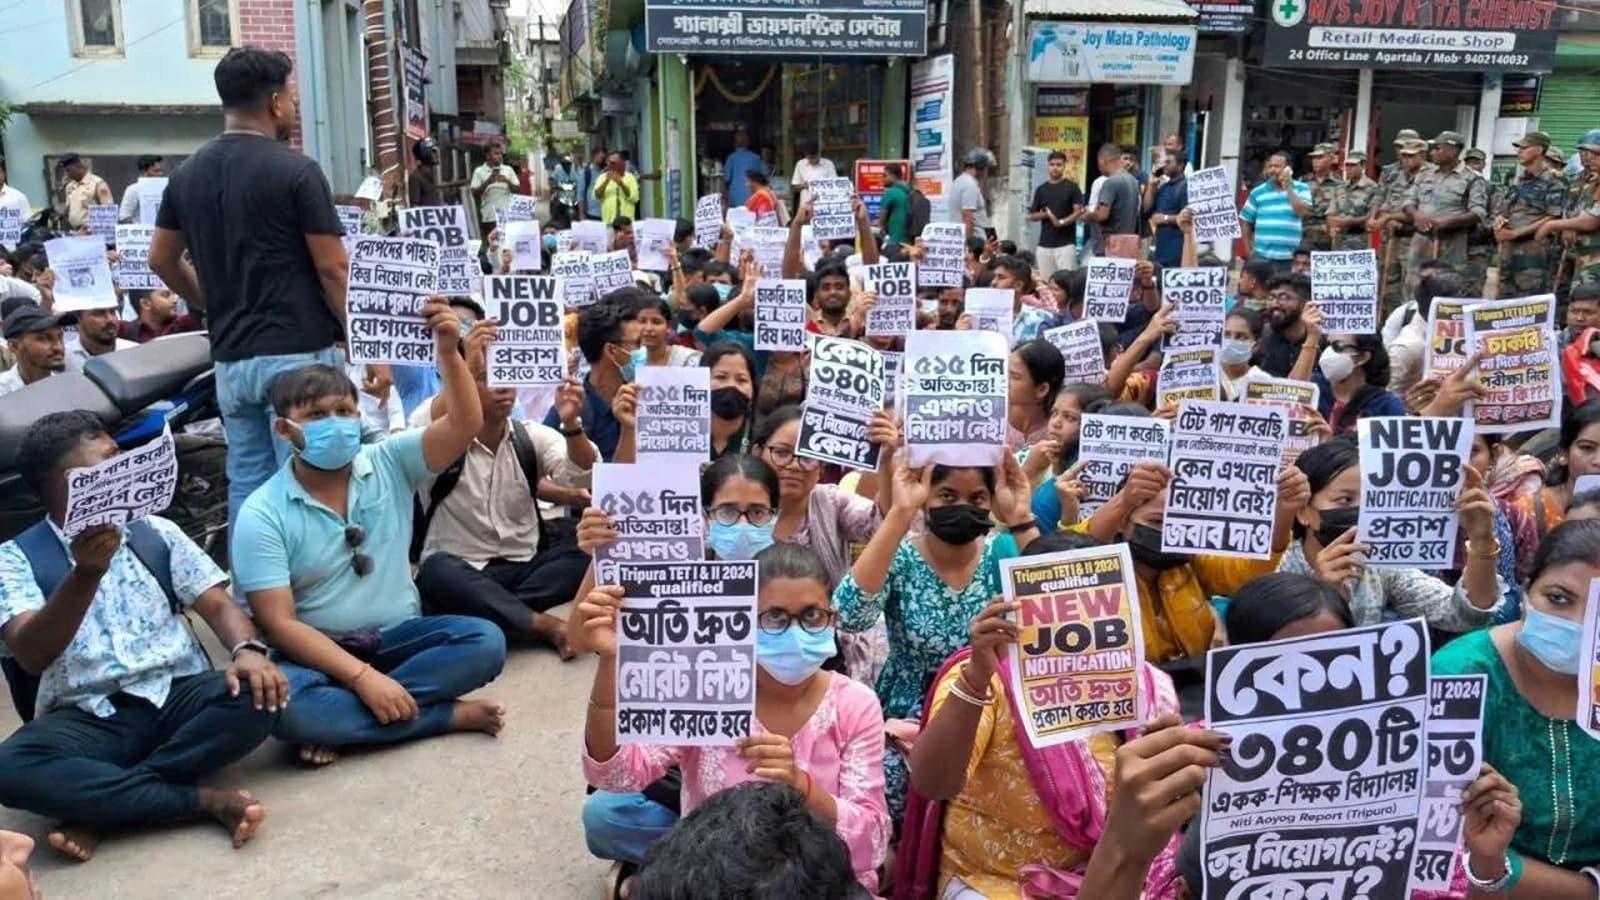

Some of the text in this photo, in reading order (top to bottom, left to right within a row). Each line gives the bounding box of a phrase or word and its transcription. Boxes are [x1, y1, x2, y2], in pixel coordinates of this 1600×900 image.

[849, 15, 901, 37] সেন্টার
[1354, 0, 1396, 25] JOY
[1465, 0, 1554, 30] CHEMIST
[1082, 30, 1190, 50] Joy Mata Pathology
[1322, 31, 1504, 48] Retail Medicine Shop
[1288, 50, 1302, 60] 24
[1306, 50, 1340, 61] Office
[1344, 51, 1369, 61] Lane
[1375, 52, 1422, 64] Agartala
[1464, 54, 1528, 65] 9402140032
[405, 208, 456, 228] NEW
[374, 263, 413, 288] নিয়োগ
[869, 264, 909, 280] NEW
[1089, 263, 1133, 281] চাকরি দাও
[493, 278, 555, 299] NEW
[758, 285, 804, 306] চাকরি দাও
[1165, 289, 1223, 305] ৩৪০টি
[491, 302, 560, 327] JOB
[1106, 303, 1126, 317] দাও
[351, 318, 432, 341] যোগ্যদের
[757, 326, 804, 346] বিষ দাও
[1488, 328, 1540, 354] চাকরি
[351, 337, 433, 361] নিয়োগ হোক!
[495, 347, 558, 364] প্রকাশ
[816, 339, 882, 380] কেন?
[493, 366, 562, 380] করতে হবে
[914, 353, 1005, 376] ৫১৫ দিন
[815, 366, 882, 402] ৩৪০টি
[919, 375, 996, 394] অতিক্রান্ত!
[1480, 371, 1524, 390] পরীক্ষা
[641, 384, 708, 403] ৫১৫ দিন
[918, 399, 993, 417] এখনও
[646, 419, 700, 433] এখনও
[805, 411, 857, 438] তবু নিয়োগ
[907, 413, 1004, 442] নিয়োগ নেই!
[1083, 418, 1168, 445] টেট পাশ করেছি,
[1180, 406, 1285, 440] টেট পাশ করেছি,
[1370, 419, 1463, 450] NEW
[639, 432, 680, 449] নিয়োগ
[808, 431, 870, 462] কেন?
[72, 457, 131, 489] টেট পাশ
[1175, 458, 1276, 485] কেন এখনো
[1368, 452, 1461, 488] JOB
[600, 490, 698, 515] ৫১৫ দিন
[1169, 480, 1275, 516] নিয়োগ নেই?
[1165, 522, 1271, 553] জবাব দাও
[1368, 515, 1450, 539] প্রকাশ
[608, 541, 689, 560] এখনও
[1361, 540, 1448, 560] করতে হবে
[621, 567, 666, 584] Tripura
[669, 567, 692, 580] TET
[693, 567, 697, 580] I
[699, 567, 710, 580] &
[711, 566, 720, 580] II
[722, 566, 753, 580] 2024
[1014, 569, 1052, 584] Tripura
[1053, 564, 1070, 578] TET
[1076, 563, 1085, 576] &
[1094, 558, 1120, 573] 2024
[1040, 574, 1099, 593] qualified
[650, 581, 724, 597] qualified
[1020, 586, 1123, 627] NEW
[620, 599, 752, 645] অতি দ্রুত
[1023, 618, 1129, 655] JOB
[619, 649, 751, 701] মেরিট লিস্ট
[1025, 650, 1132, 677] NOTIFICATION
[1215, 623, 1420, 715] কেন?
[1029, 677, 1133, 706] অতি দ্রুত
[1444, 680, 1481, 699] 2024
[618, 708, 752, 739] প্রকাশ করতে হবে
[1032, 698, 1134, 729] প্রকাশ করতে হবে
[1222, 706, 1420, 783] ৩৪০টি
[1211, 768, 1418, 814] একক-শিক্ষক বিদ্যালয়
[1230, 818, 1251, 829] Niti
[1299, 811, 1342, 824] Report
[1206, 826, 1415, 881] তবু নিয়োগ নেই?
[1414, 850, 1453, 882] হবে
